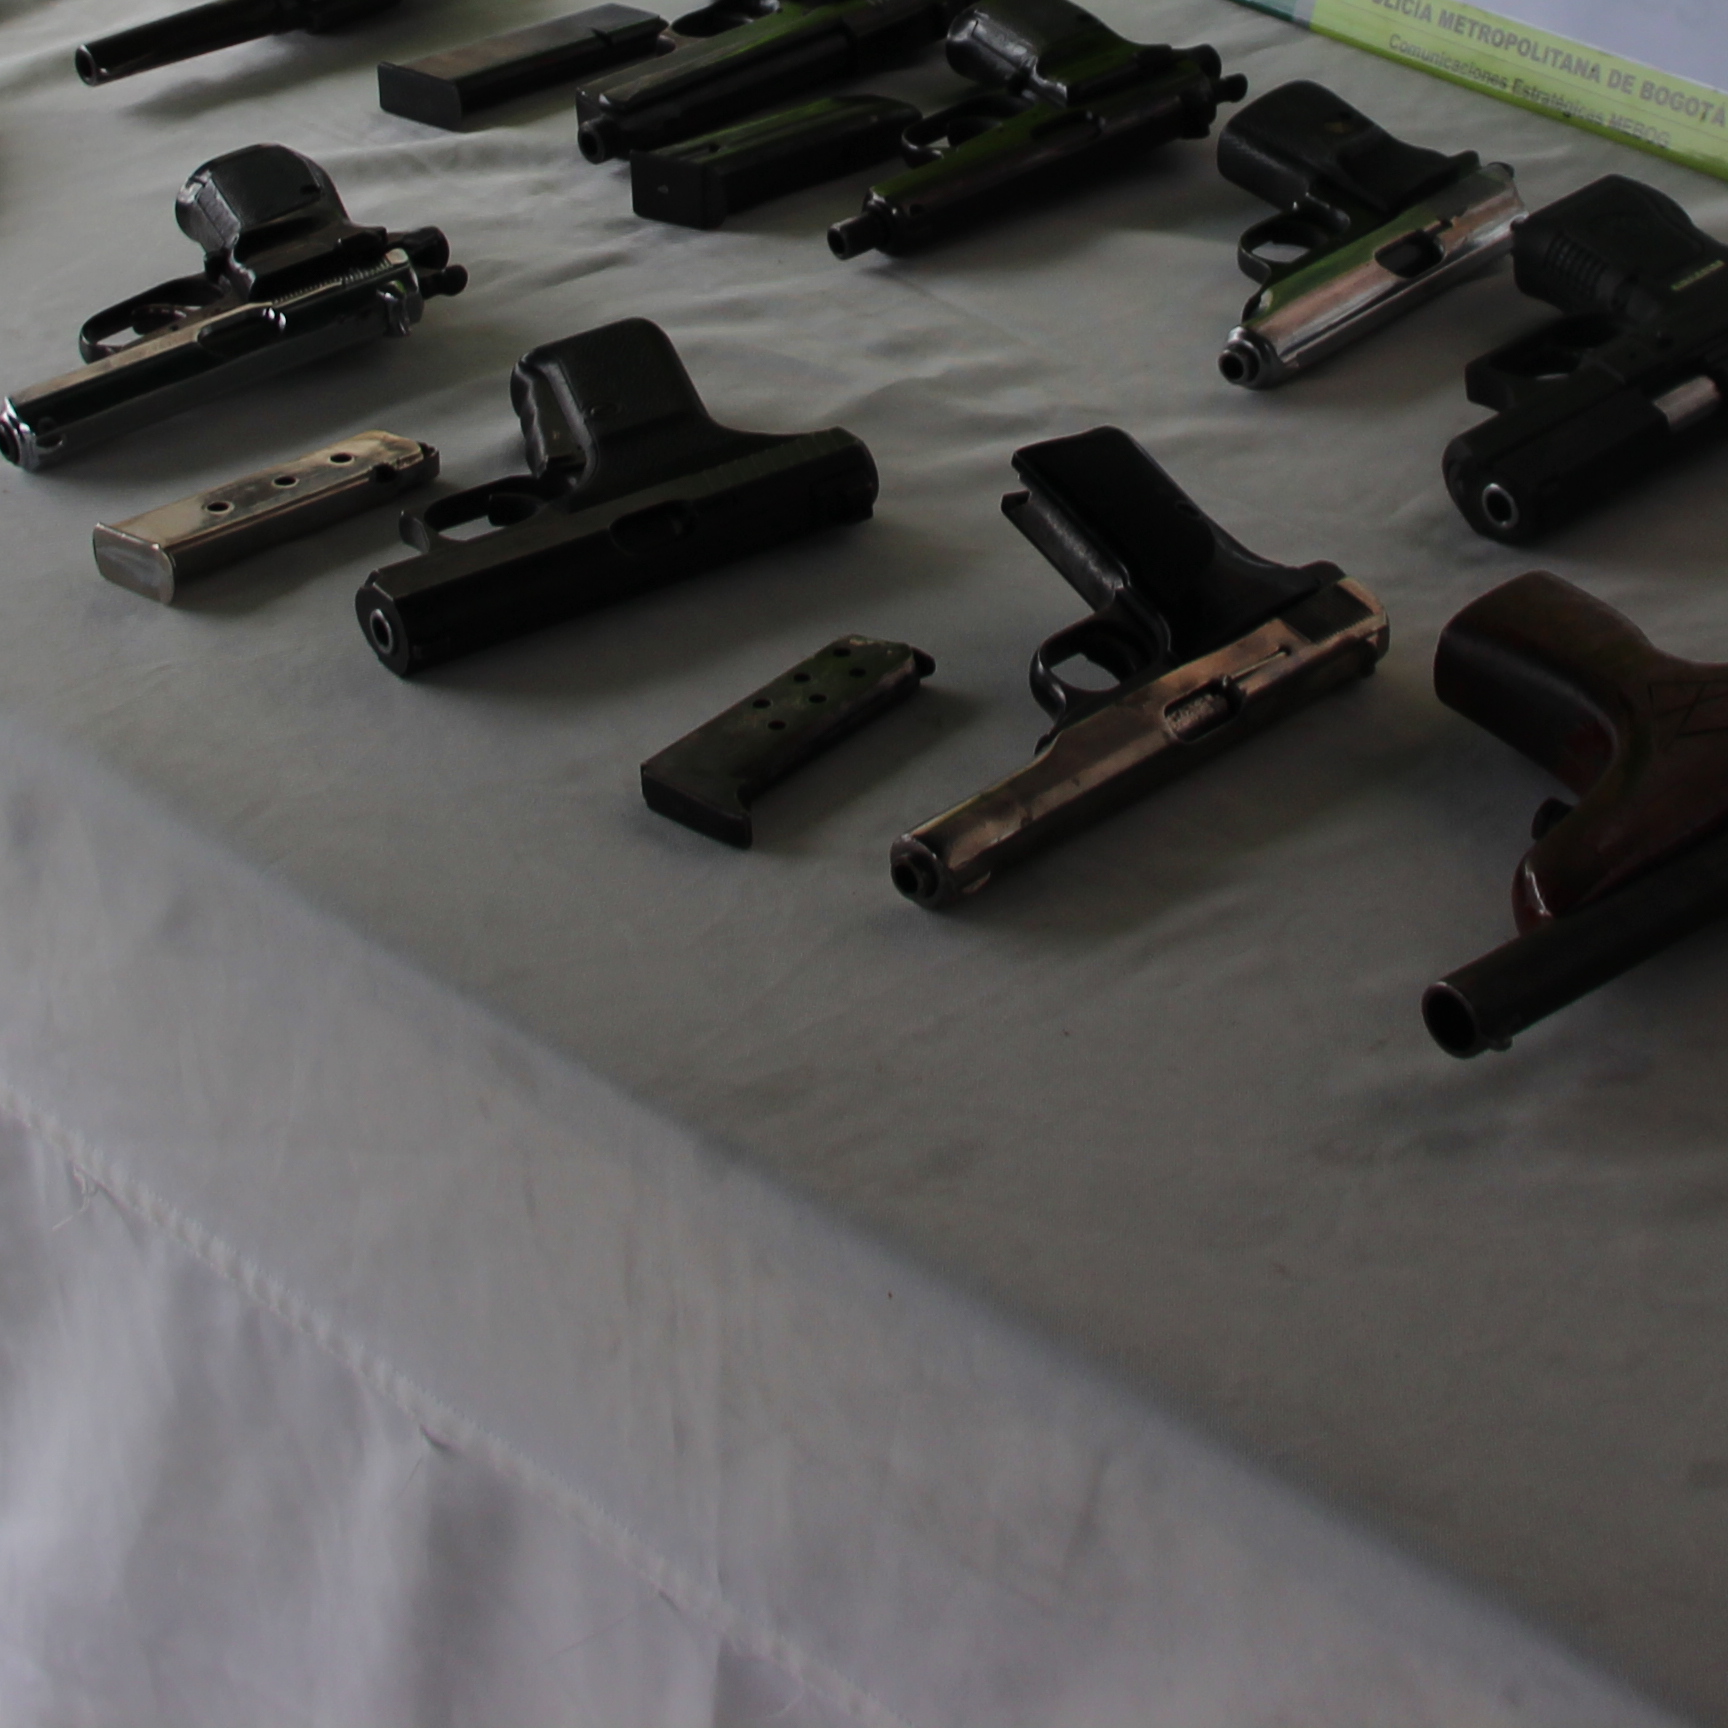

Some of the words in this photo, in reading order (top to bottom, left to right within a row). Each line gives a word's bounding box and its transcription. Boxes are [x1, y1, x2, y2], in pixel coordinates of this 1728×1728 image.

[1389, 34, 1508, 89] Comunicaciones
[1438, 9, 1601, 84] METROPOLITANA
[1607, 69, 1636, 94] DE
[1639, 80, 1727, 127] BOGOTÁ
